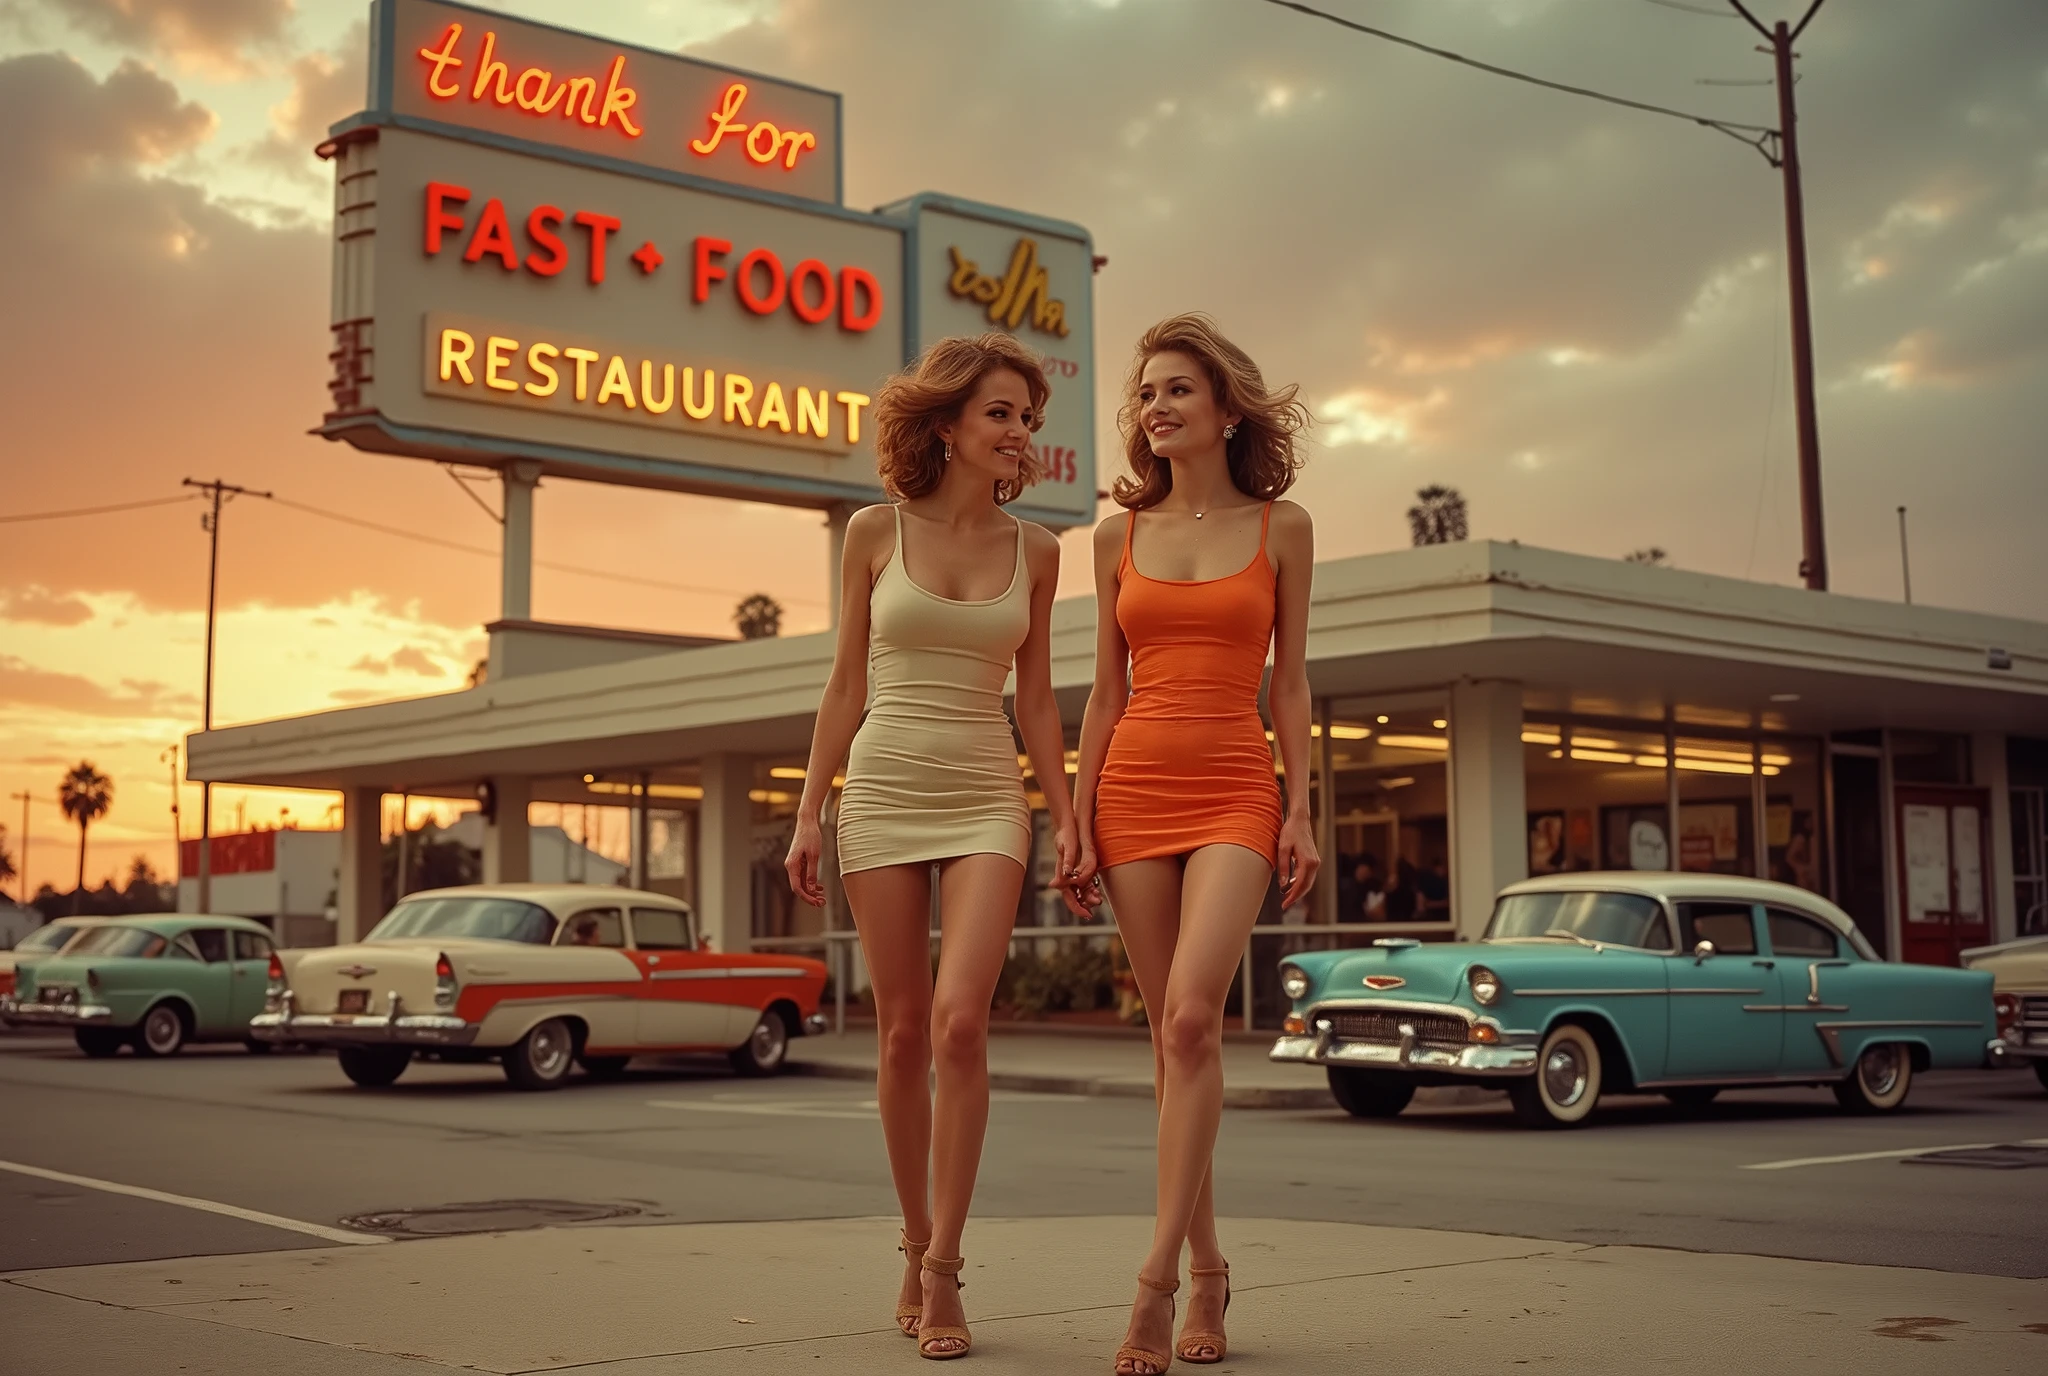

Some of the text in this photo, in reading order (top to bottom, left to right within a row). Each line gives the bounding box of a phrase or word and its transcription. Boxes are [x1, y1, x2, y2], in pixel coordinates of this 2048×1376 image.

[418, 22, 817, 169] thank for
[423, 180, 622, 285] FAST
[692, 235, 883, 333] FOOD
[440, 328, 871, 444] RESTAUURANT
